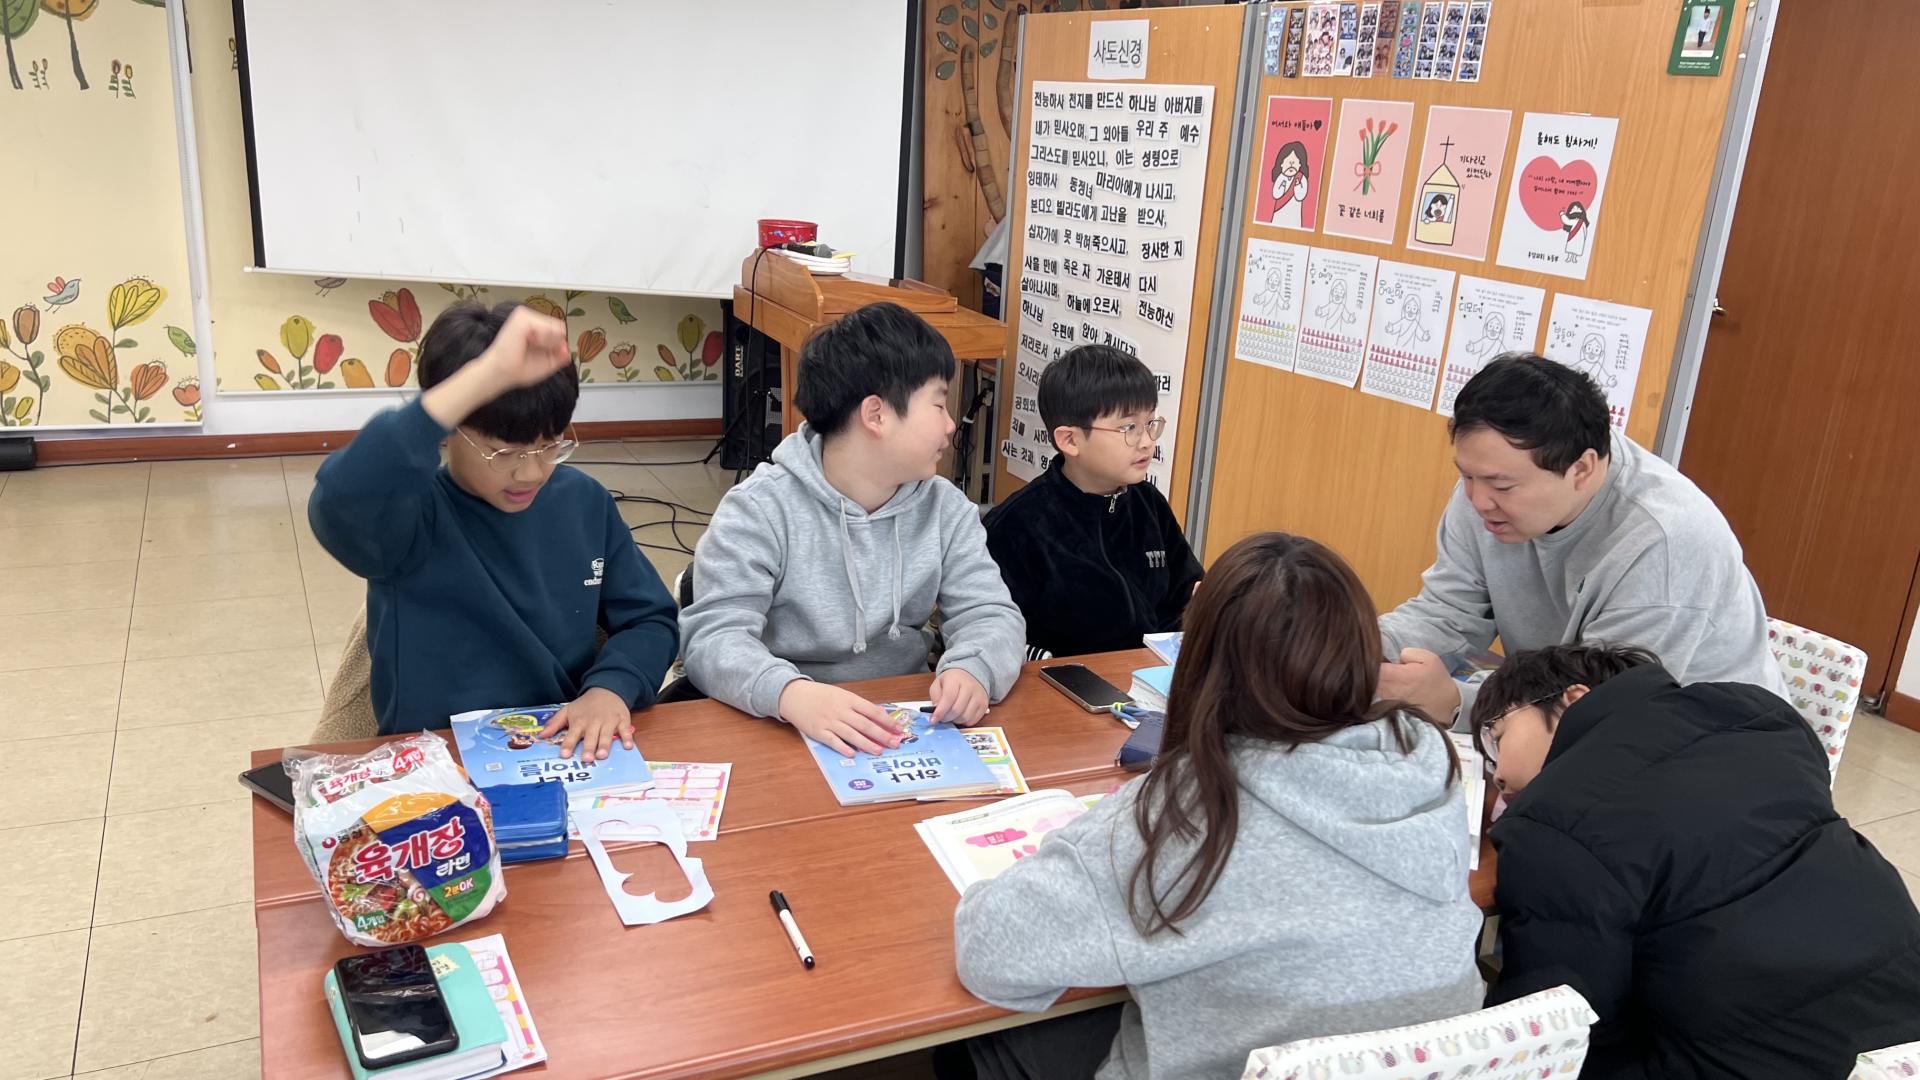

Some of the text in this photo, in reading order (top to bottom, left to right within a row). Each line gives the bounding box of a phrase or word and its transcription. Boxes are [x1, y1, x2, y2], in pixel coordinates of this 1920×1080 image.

[1093, 39, 1142, 65] 사도신경
[1035, 92, 1064, 110] 전능하사
[1097, 91, 1124, 109] 만드신
[1129, 95, 1157, 112] 하나님
[1164, 96, 1203, 114] 아버지를
[1035, 120, 1050, 136] 내가
[1089, 126, 1098, 142] 그
[1103, 125, 1129, 142] 외아들
[1136, 119, 1154, 137] 우리
[1158, 121, 1169, 138] 주
[1180, 124, 1199, 143] 예수
[1537, 131, 1598, 150] 올해도 힘차게!
[1031, 144, 1179, 168] 그리스도를 믿사오니, 이는 성령으로
[1459, 155, 1486, 166] 기다리고
[1028, 170, 1057, 189] 잉태하사
[1070, 176, 1093, 200] 동정녀
[1096, 171, 1142, 199] 마리아에게
[1031, 198, 1167, 228] 본디오 빌라도에게 고난을 받으사,
[1338, 204, 1385, 224] 꽃 같은 너희를
[1028, 224, 1058, 244] 십자가에
[1064, 228, 1072, 245] 못
[1076, 232, 1091, 251] 박혀
[1142, 241, 1169, 260] 장사한
[1174, 240, 1183, 257] 지
[1025, 256, 1040, 272] 사흘
[1044, 259, 1057, 275] 만에
[1064, 258, 1078, 276] 죽은
[1082, 263, 1091, 279] 자
[1139, 276, 1156, 293] 다시
[1022, 299, 1044, 323] 하나님
[1052, 322, 1075, 341] 우편에
[1082, 322, 1098, 344] 앉아
[1067, 294, 1091, 314] 하늘에
[1139, 300, 1174, 329] 전능하신
[1021, 334, 1049, 358] 저리로서
[1018, 362, 1041, 386] 오시리
[1012, 417, 1051, 445] 죄를 사하
[1002, 441, 1018, 458] 사는
[1040, 454, 1052, 470] 영
[872, 757, 943, 773] 바이블
[890, 769, 941, 783] 하나
[329, 767, 372, 790] 육개장
[355, 816, 466, 885] 육개장
[435, 853, 472, 877] 라면
[357, 912, 386, 931] 4개입
